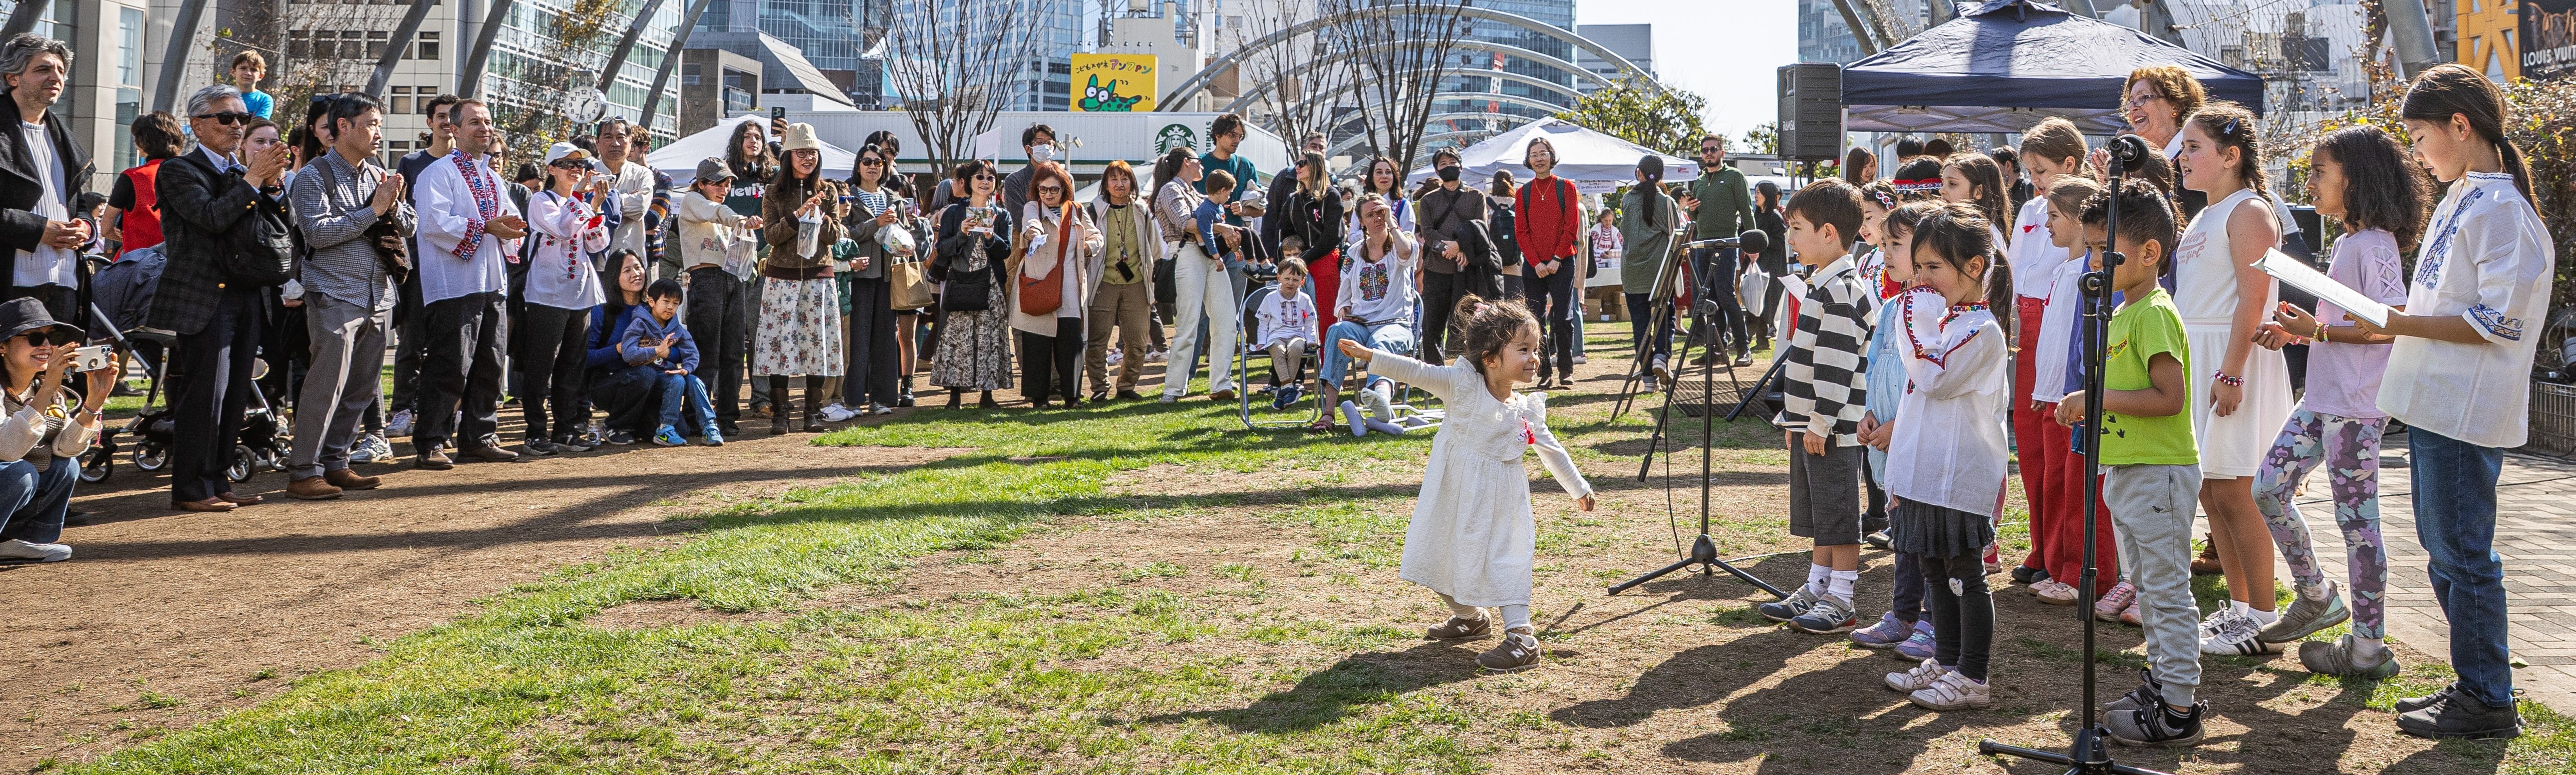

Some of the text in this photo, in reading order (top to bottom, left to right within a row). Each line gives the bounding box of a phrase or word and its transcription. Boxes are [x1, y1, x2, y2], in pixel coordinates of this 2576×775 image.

[2524, 49, 2552, 67] LOUIS
[2186, 245, 2205, 264] girl
[1790, 599, 1810, 614] N
[1826, 610, 1845, 625] N
[2246, 616, 2259, 628] adidas
[1456, 624, 1470, 633] N
[1510, 649, 1525, 658] N
